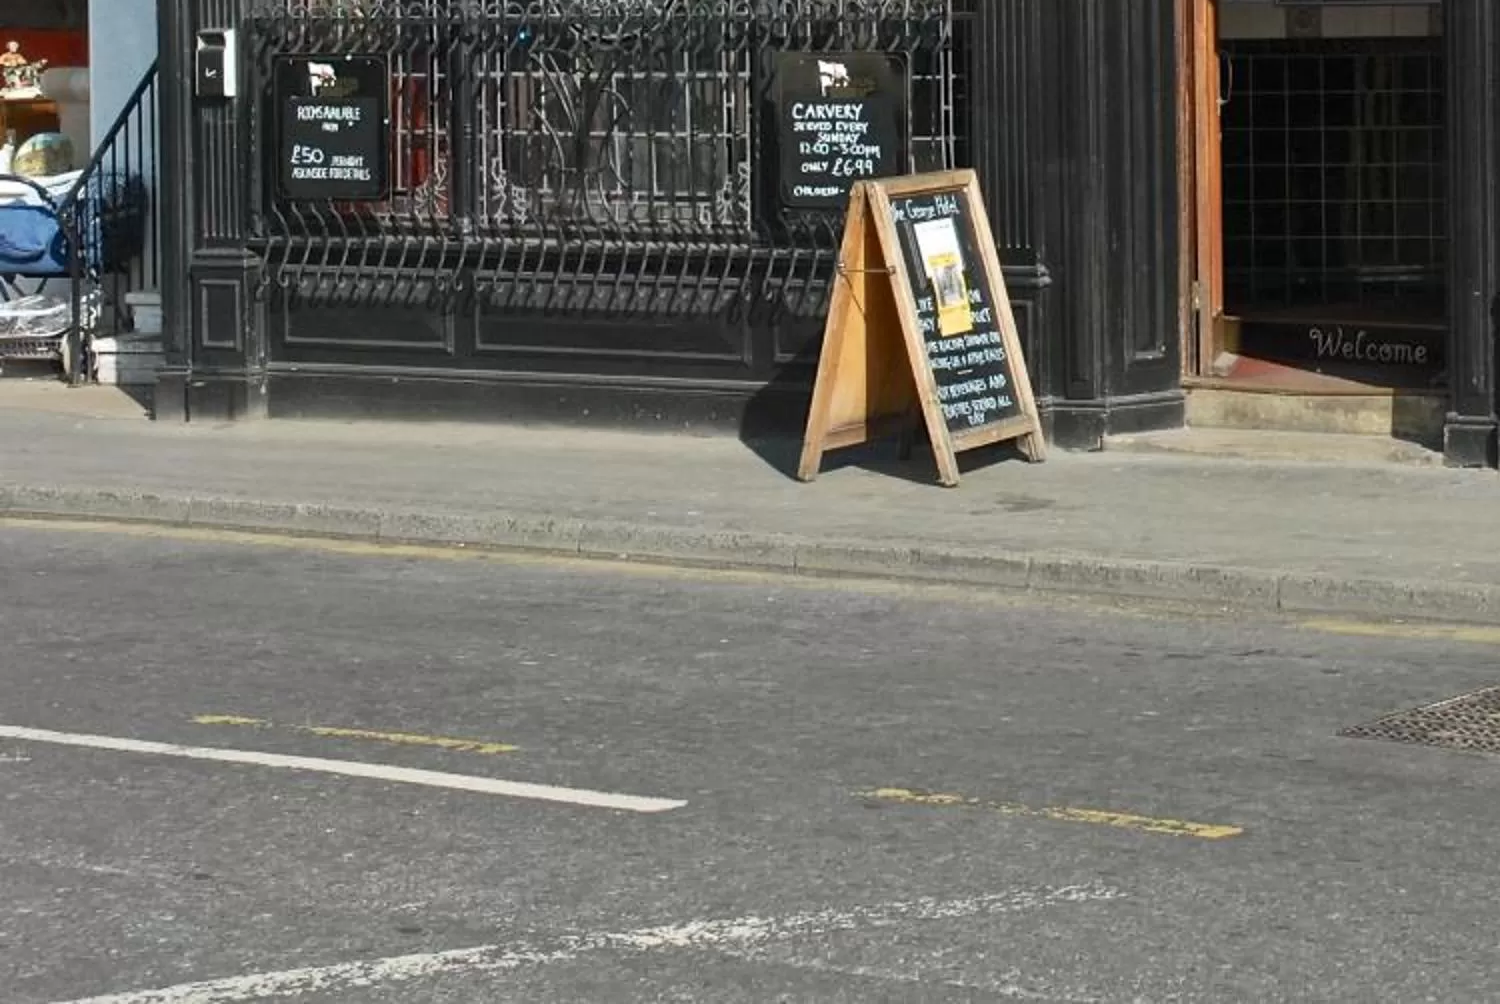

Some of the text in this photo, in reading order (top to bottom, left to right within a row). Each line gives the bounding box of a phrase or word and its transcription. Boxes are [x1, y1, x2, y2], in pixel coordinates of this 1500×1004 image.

[791, 102, 863, 121] CARVERY
[793, 121, 869, 134] SERVED EVERY
[818, 132, 861, 144] SUNDAY
[290, 143, 325, 165] £50
[801, 161, 829, 173] ONLY
[1309, 326, 1427, 364] Welcome
